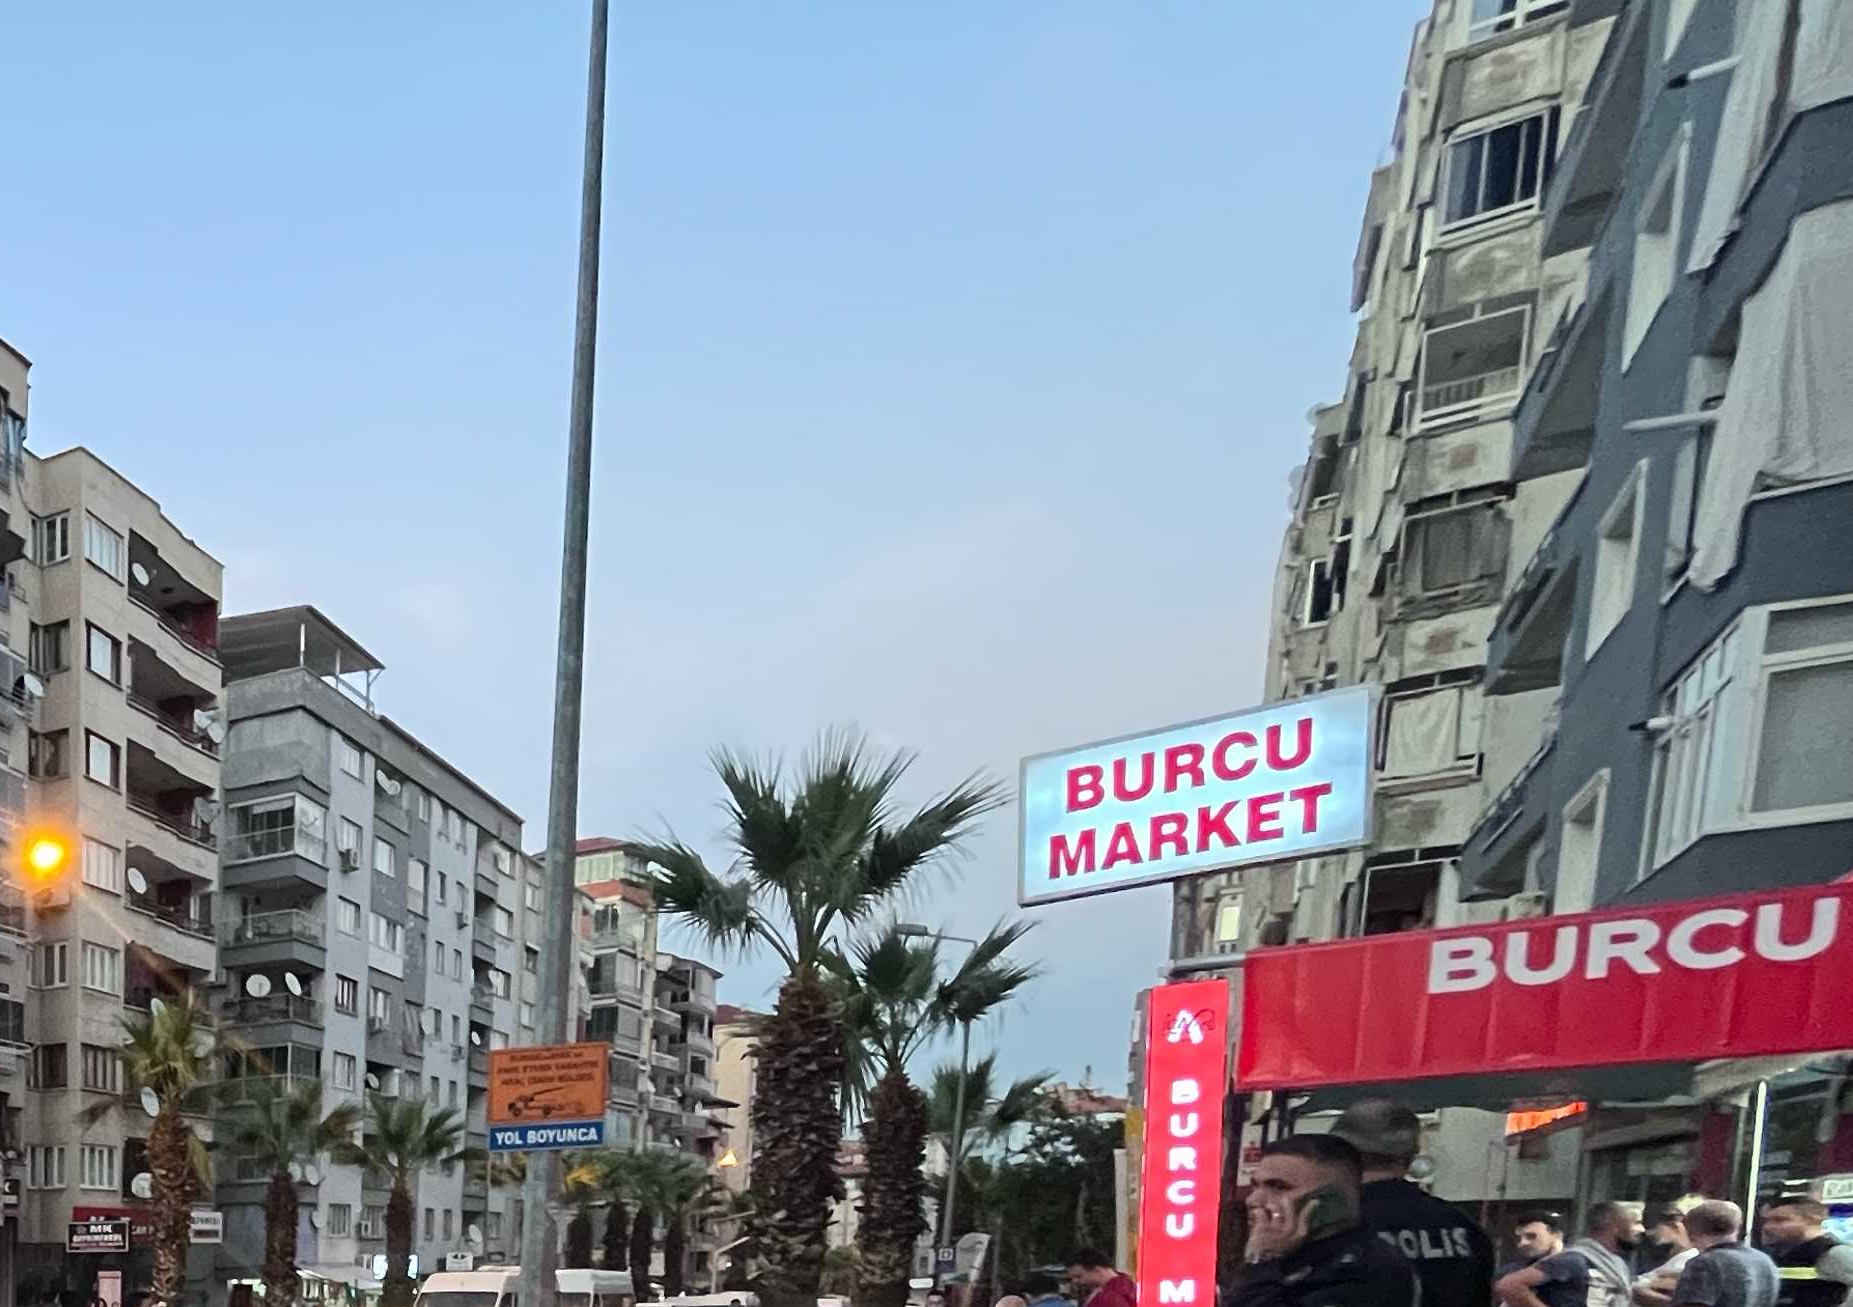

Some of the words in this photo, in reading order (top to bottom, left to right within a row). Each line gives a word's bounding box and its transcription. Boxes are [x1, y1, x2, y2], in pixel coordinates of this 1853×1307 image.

[1066, 717, 1314, 813] BURCU
[1048, 782, 1333, 880] MARKET
[1427, 897, 1841, 994] BURCU
[495, 1130, 524, 1146] YOL
[526, 1127, 598, 1144] BOYUNCA
[1164, 1077, 1200, 1239] BURCU
